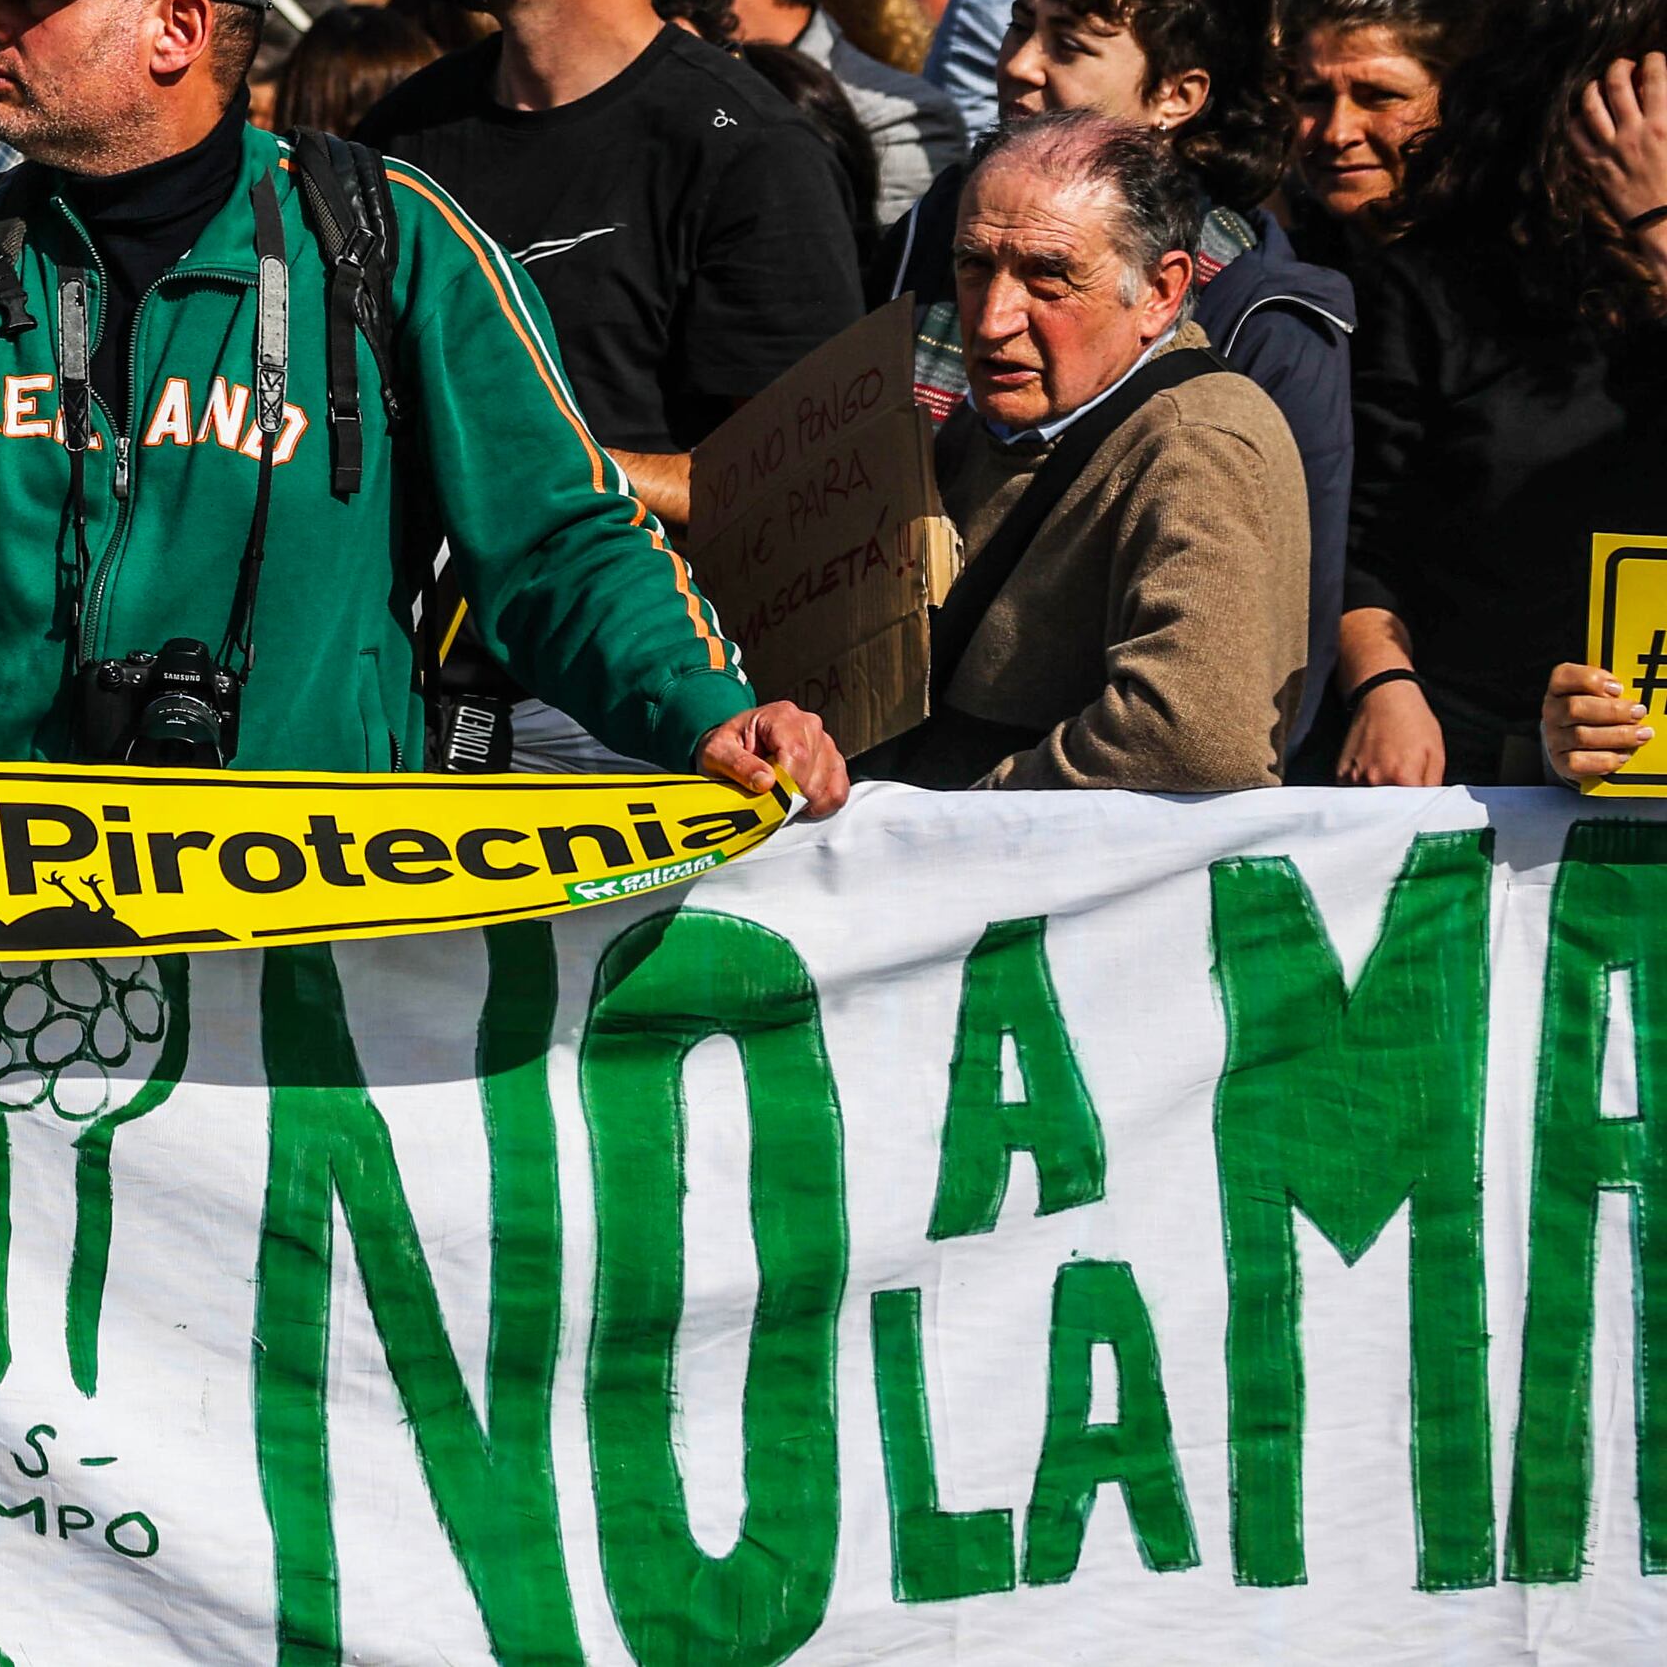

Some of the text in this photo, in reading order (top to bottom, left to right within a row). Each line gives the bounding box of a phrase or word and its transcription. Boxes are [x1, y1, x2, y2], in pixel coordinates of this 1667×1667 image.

[786, 448, 873, 541] PARA
[163, 672, 201, 682] SAMSUNG
[448, 705, 496, 763] TUNED
[255, 907, 1108, 1667] NO A
[869, 1251, 1205, 1604] LA
